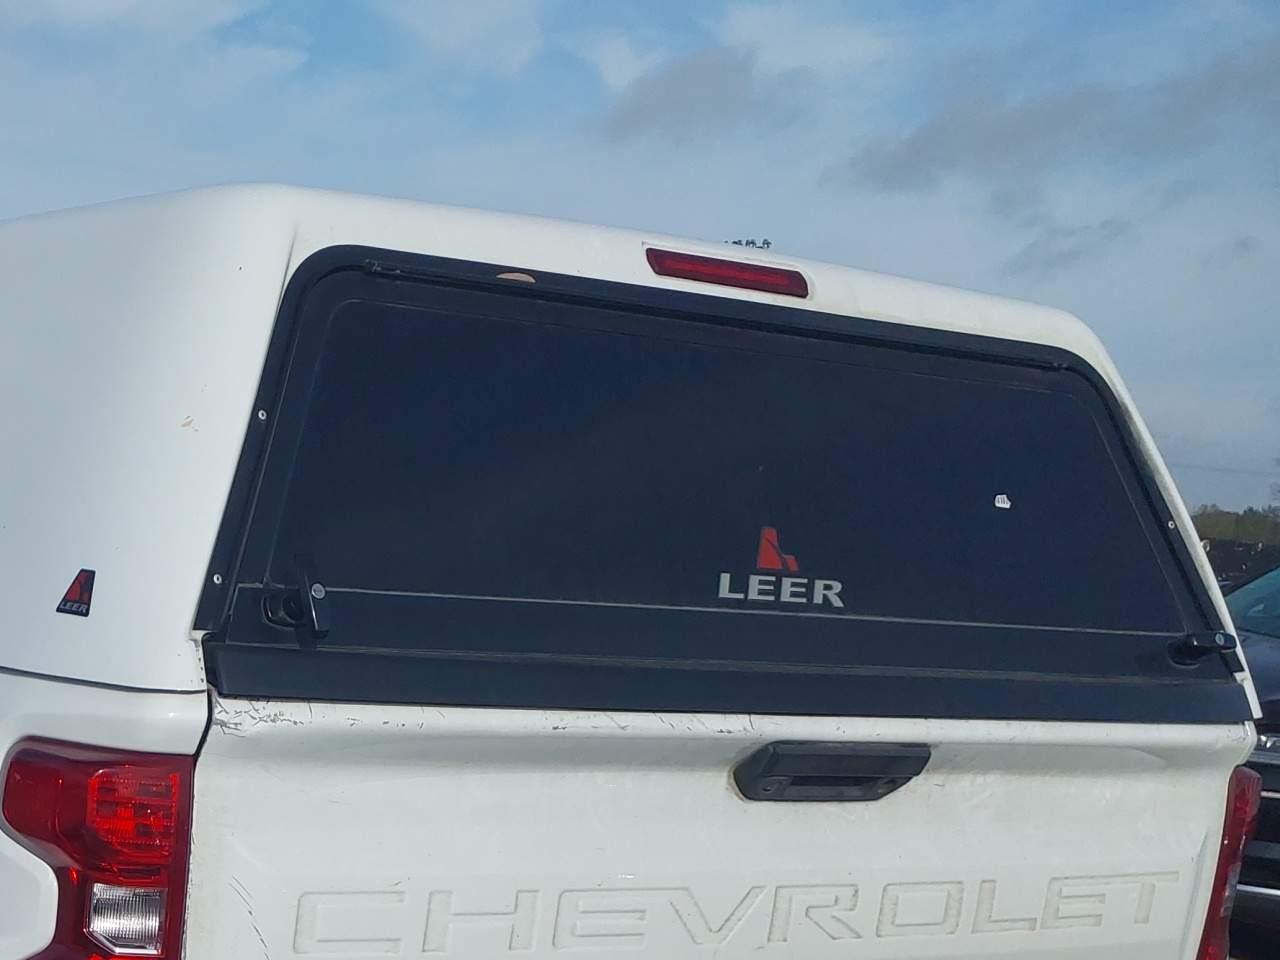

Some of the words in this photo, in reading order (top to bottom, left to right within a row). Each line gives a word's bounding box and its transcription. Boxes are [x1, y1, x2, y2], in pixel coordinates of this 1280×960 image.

[60, 602, 88, 613] LEER
[718, 572, 845, 608] LEER
[293, 871, 1181, 954] CHEVROLET
